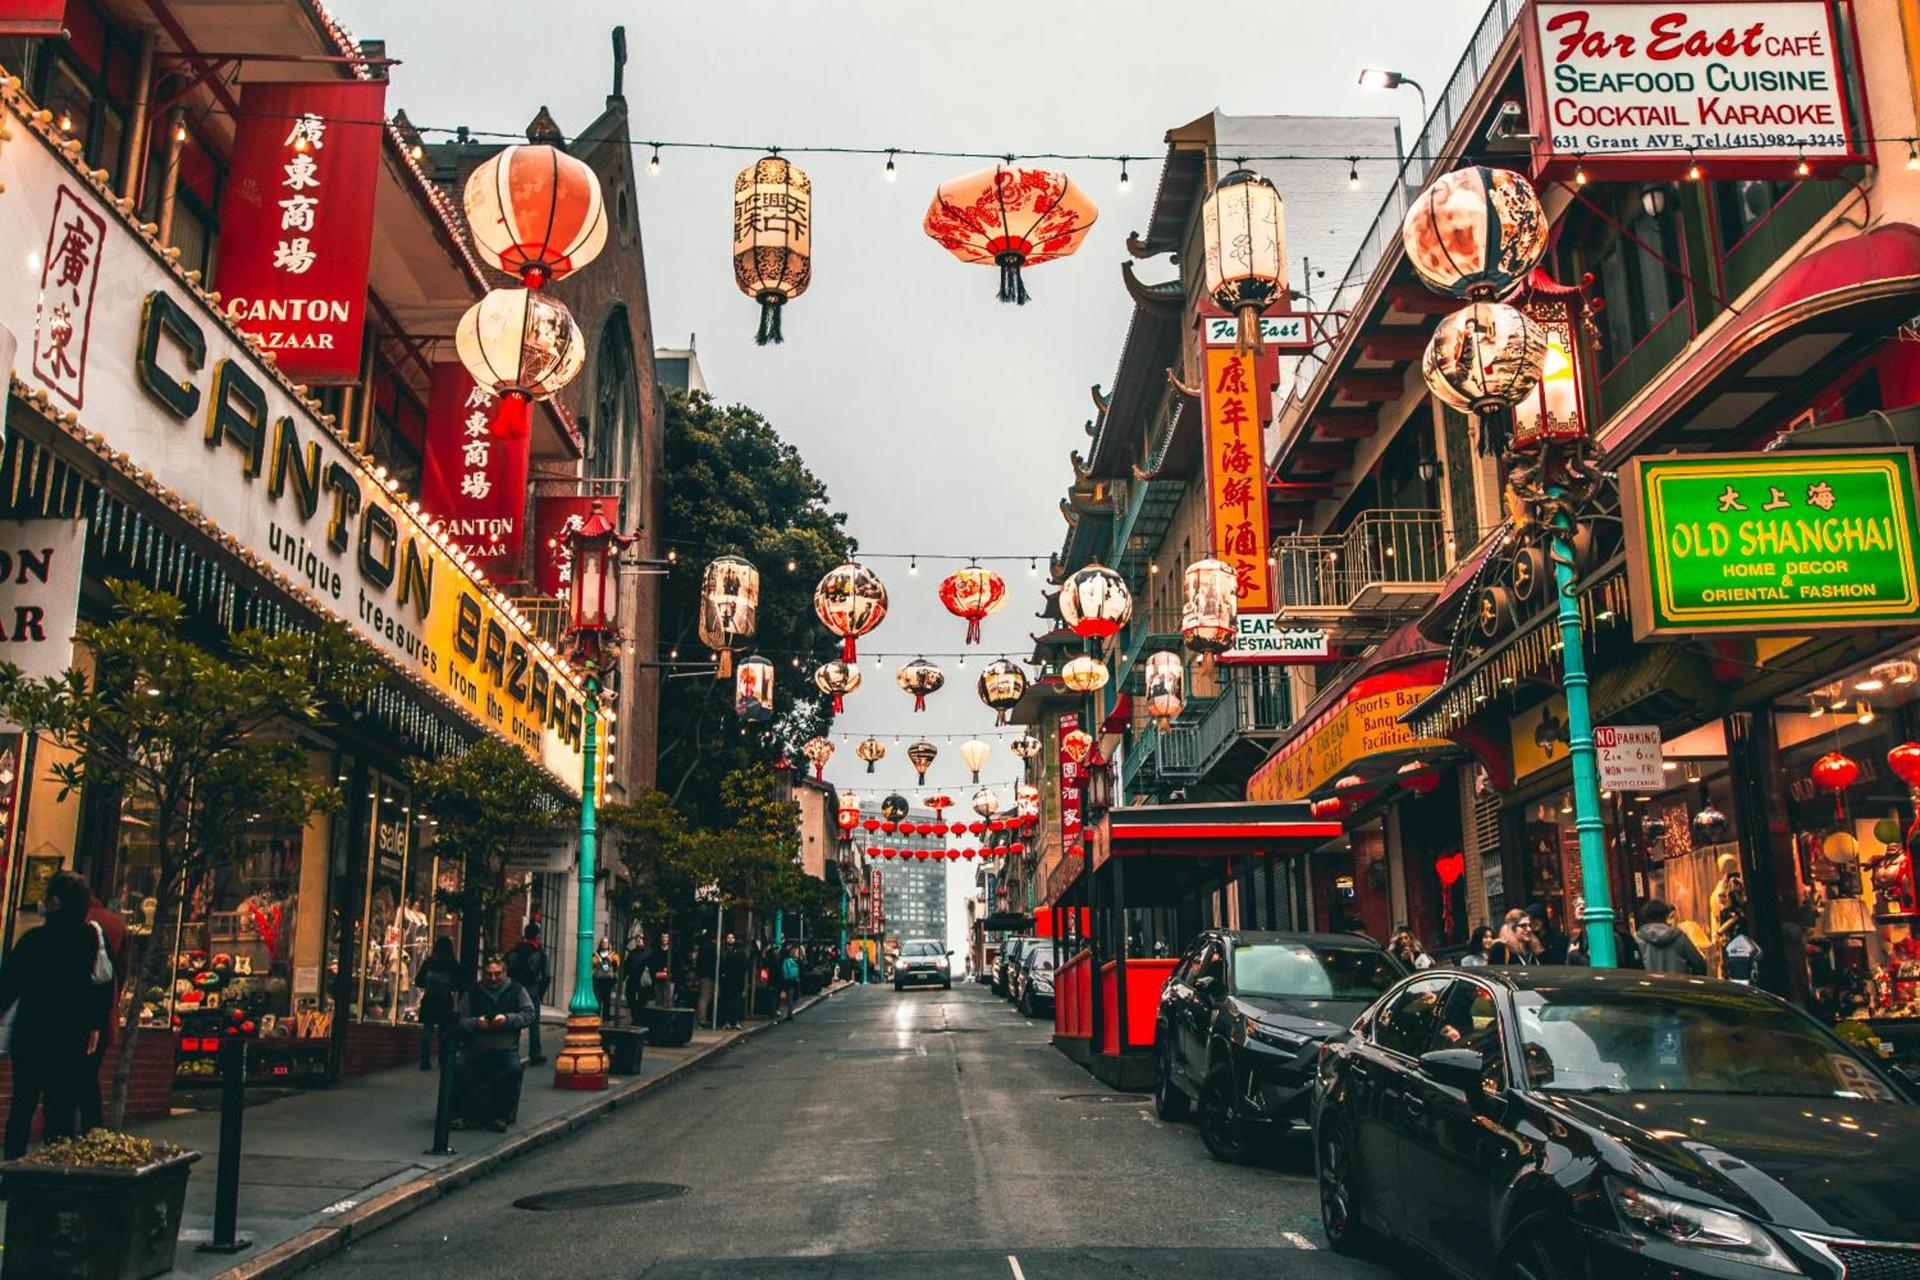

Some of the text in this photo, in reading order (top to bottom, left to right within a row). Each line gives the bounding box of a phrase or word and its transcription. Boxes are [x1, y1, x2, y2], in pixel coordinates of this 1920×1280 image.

[1546, 11, 1825, 63] Far East CAFÉ
[1554, 62, 1829, 93] SEAFOOD CUISINE
[1554, 96, 1835, 127] COCKTAIL KARAOKE
[1552, 135, 1579, 148] 631
[1586, 135, 1639, 148] Grant
[273, 112, 327, 275] 廣東商場
[227, 297, 350, 322] CANTON
[245, 332, 334, 350] AZAAR
[1212, 320, 1236, 340] Fa
[1718, 481, 1836, 512] 大上海
[136, 289, 583, 754] CANTON BAZAAR
[1672, 516, 1894, 558] OLD SHANGHAI
[1723, 560, 1848, 577] HOME DECOR
[1781, 574, 1794, 587] &
[1702, 584, 1877, 602] ORIENTAL FASHION
[269, 522, 541, 752] unique treasures from the orient
[1234, 638, 1321, 650] ESTAURANT
[1354, 691, 1421, 718] Sports Bar
[1596, 729, 1657, 746] NO PARKING
[1605, 766, 1621, 776] MON
[1641, 764, 1655, 775] FRI
[379, 822, 405, 857] sale
